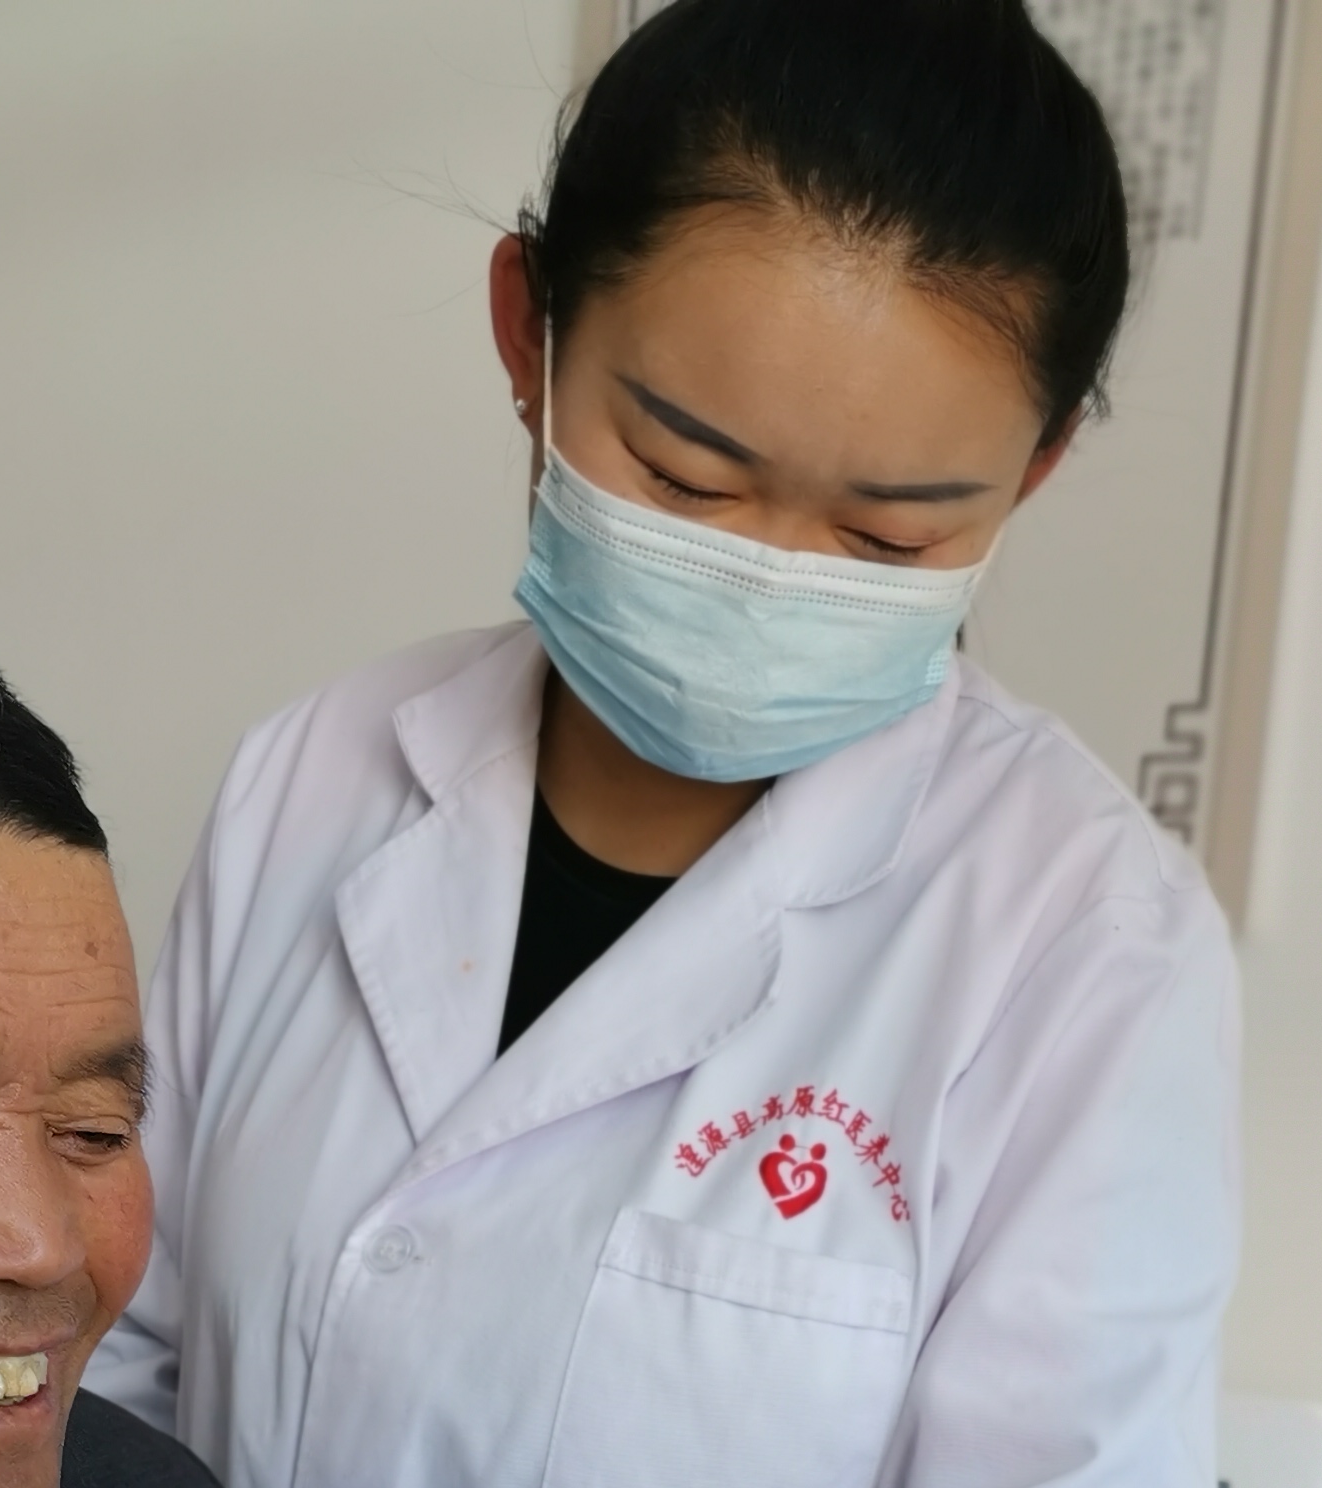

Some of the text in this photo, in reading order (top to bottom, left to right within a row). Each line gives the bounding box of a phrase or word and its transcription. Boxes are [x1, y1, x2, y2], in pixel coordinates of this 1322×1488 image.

[674, 1085, 912, 1222] 湟源县高原红医养中心
